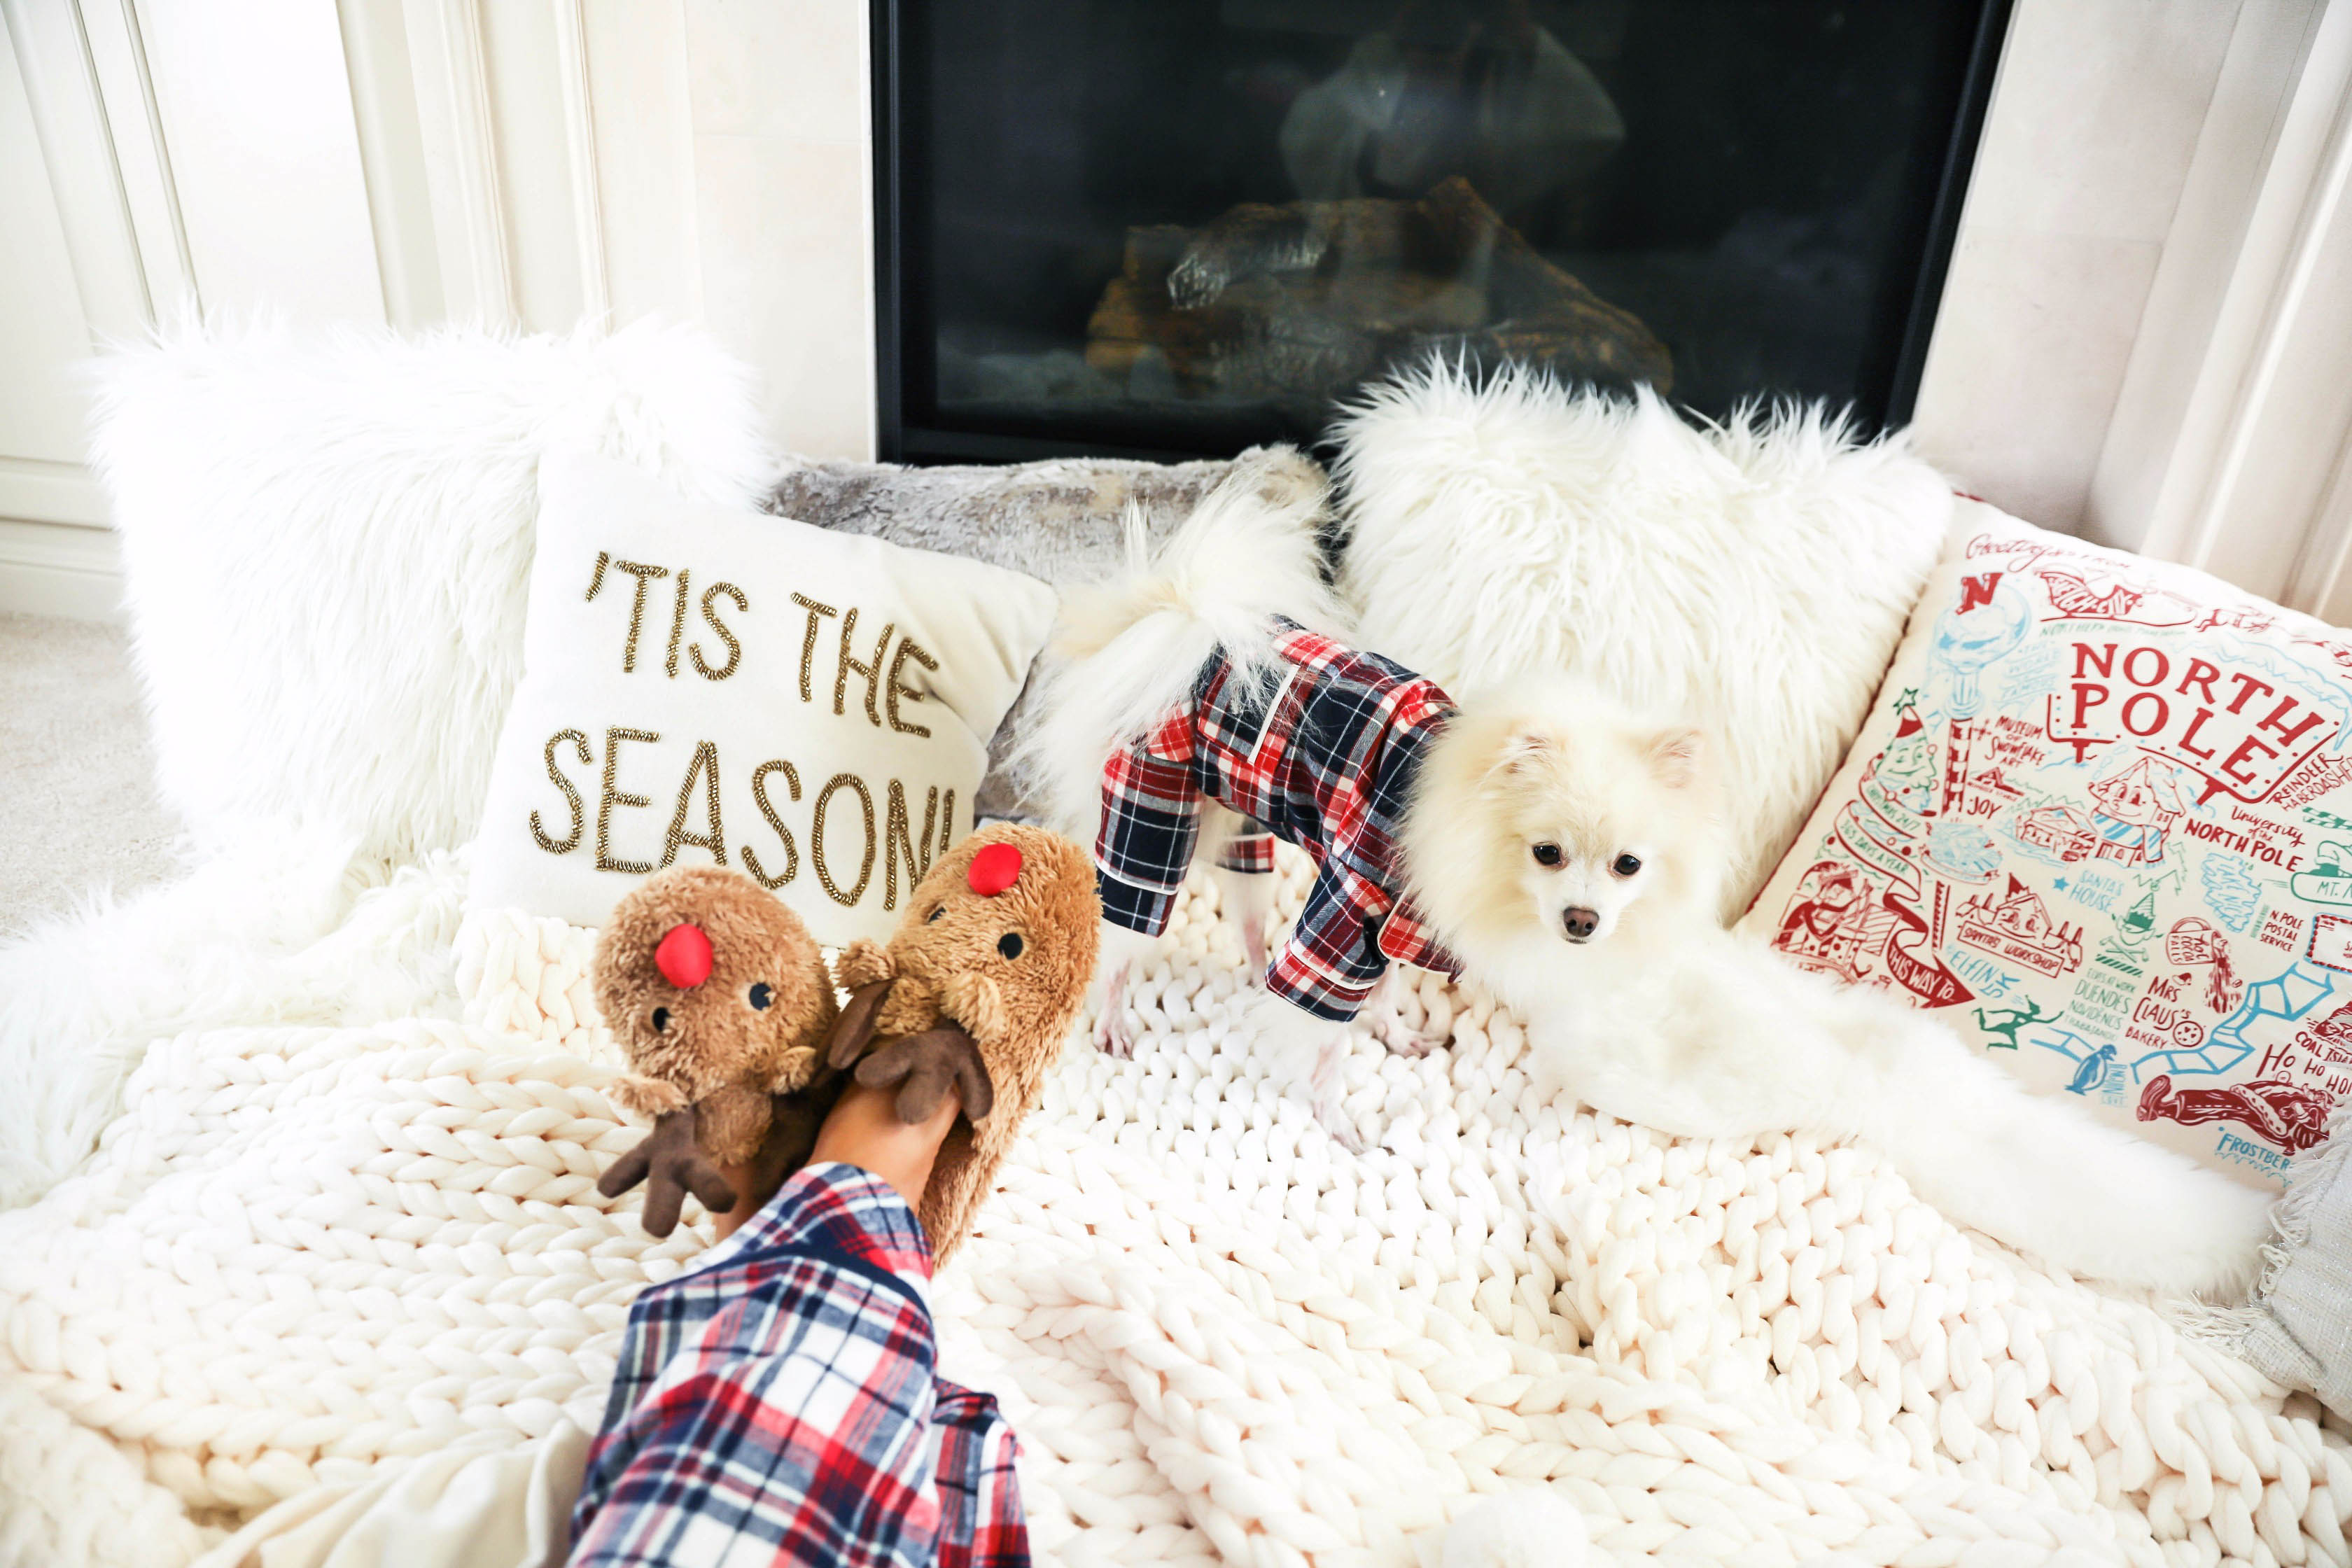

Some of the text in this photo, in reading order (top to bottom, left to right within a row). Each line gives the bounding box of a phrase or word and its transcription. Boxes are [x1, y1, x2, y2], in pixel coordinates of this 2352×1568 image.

[585, 551, 940, 738] 'TIS THE
[2070, 642, 2325, 747] NORTH
[1995, 715, 2044, 740] MUSEUM
[2070, 682, 2279, 785] POLE
[2266, 752, 2344, 804] REINDEER
[1967, 796, 2002, 819] JOY
[2232, 806, 2305, 847] University
[1854, 836, 1878, 858] DAYS
[1885, 856, 1909, 874] YEAR
[2184, 818, 2304, 872] NORTH POLE
[2069, 883, 2115, 913] HOUSE
[2316, 880, 2342, 897] MT.
[2264, 921, 2298, 941] POSTAL
[2279, 912, 2305, 930] POLE
[2194, 932, 2210, 959] HOT
[2260, 933, 2294, 953] SERVICE
[1889, 944, 1912, 981] THIS
[1908, 964, 1943, 995] WAY
[2073, 979, 2134, 1014] DUENDES
[2124, 1026, 2169, 1049] BAKERY
[2295, 1031, 2323, 1058] COAL
[2217, 1132, 2295, 1171] FROSTBER
